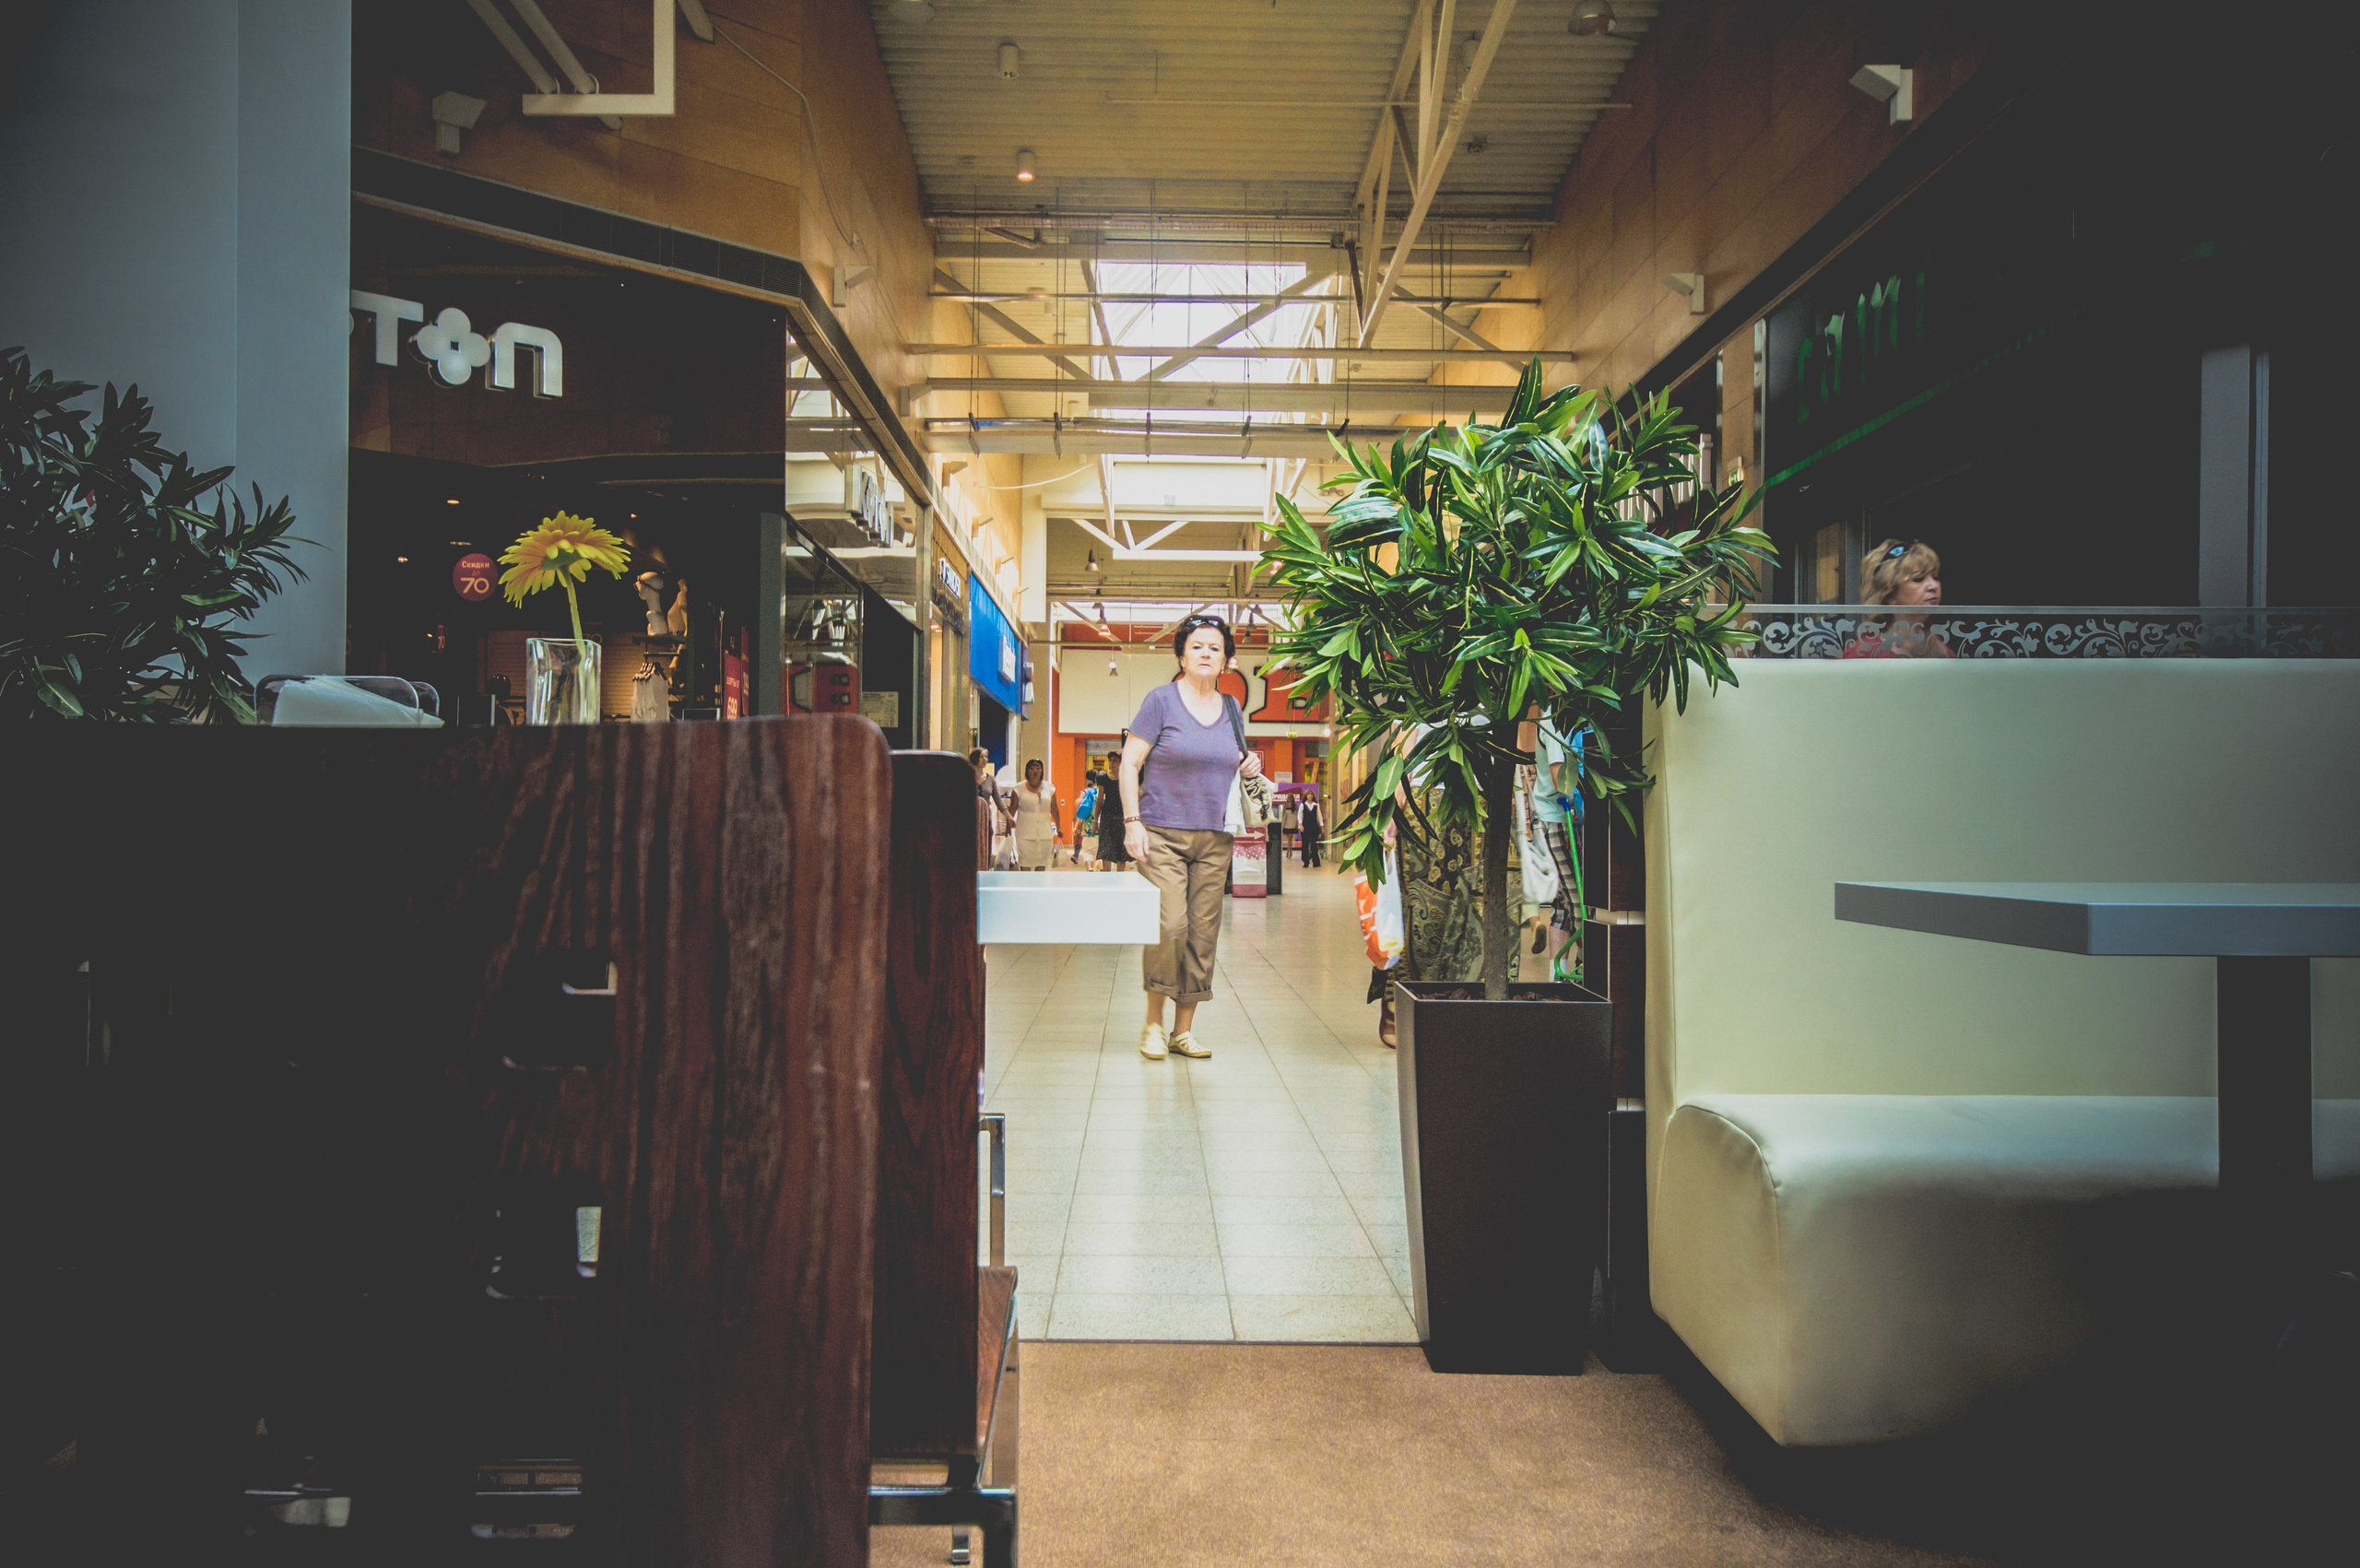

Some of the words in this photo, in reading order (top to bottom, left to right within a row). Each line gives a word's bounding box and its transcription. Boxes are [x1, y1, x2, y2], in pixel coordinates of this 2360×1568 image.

[349, 289, 563, 399] TOn
[461, 560, 490, 569] Скидки
[460, 577, 490, 594] 70
